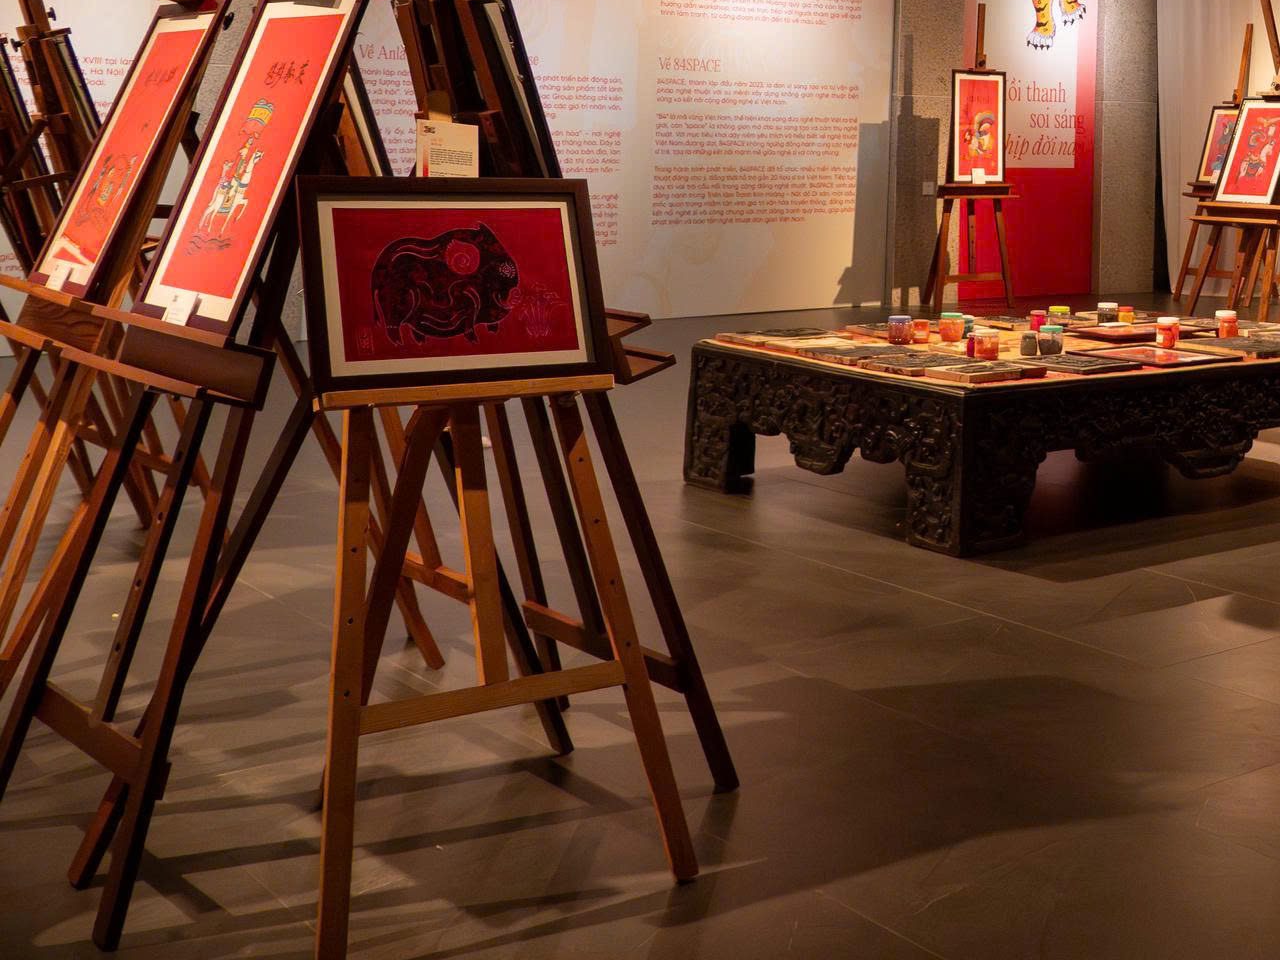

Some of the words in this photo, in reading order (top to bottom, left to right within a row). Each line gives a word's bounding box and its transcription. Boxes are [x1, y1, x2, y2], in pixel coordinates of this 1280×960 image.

[658, 56, 672, 71] Về
[673, 57, 721, 73] 84SPACE
[1007, 78, 1021, 102] ồi
[1026, 81, 1067, 103] thanh
[1030, 107, 1050, 129] soi
[1054, 108, 1086, 135] sáng
[1006, 134, 1030, 161] hịp
[1031, 134, 1057, 156] đời
